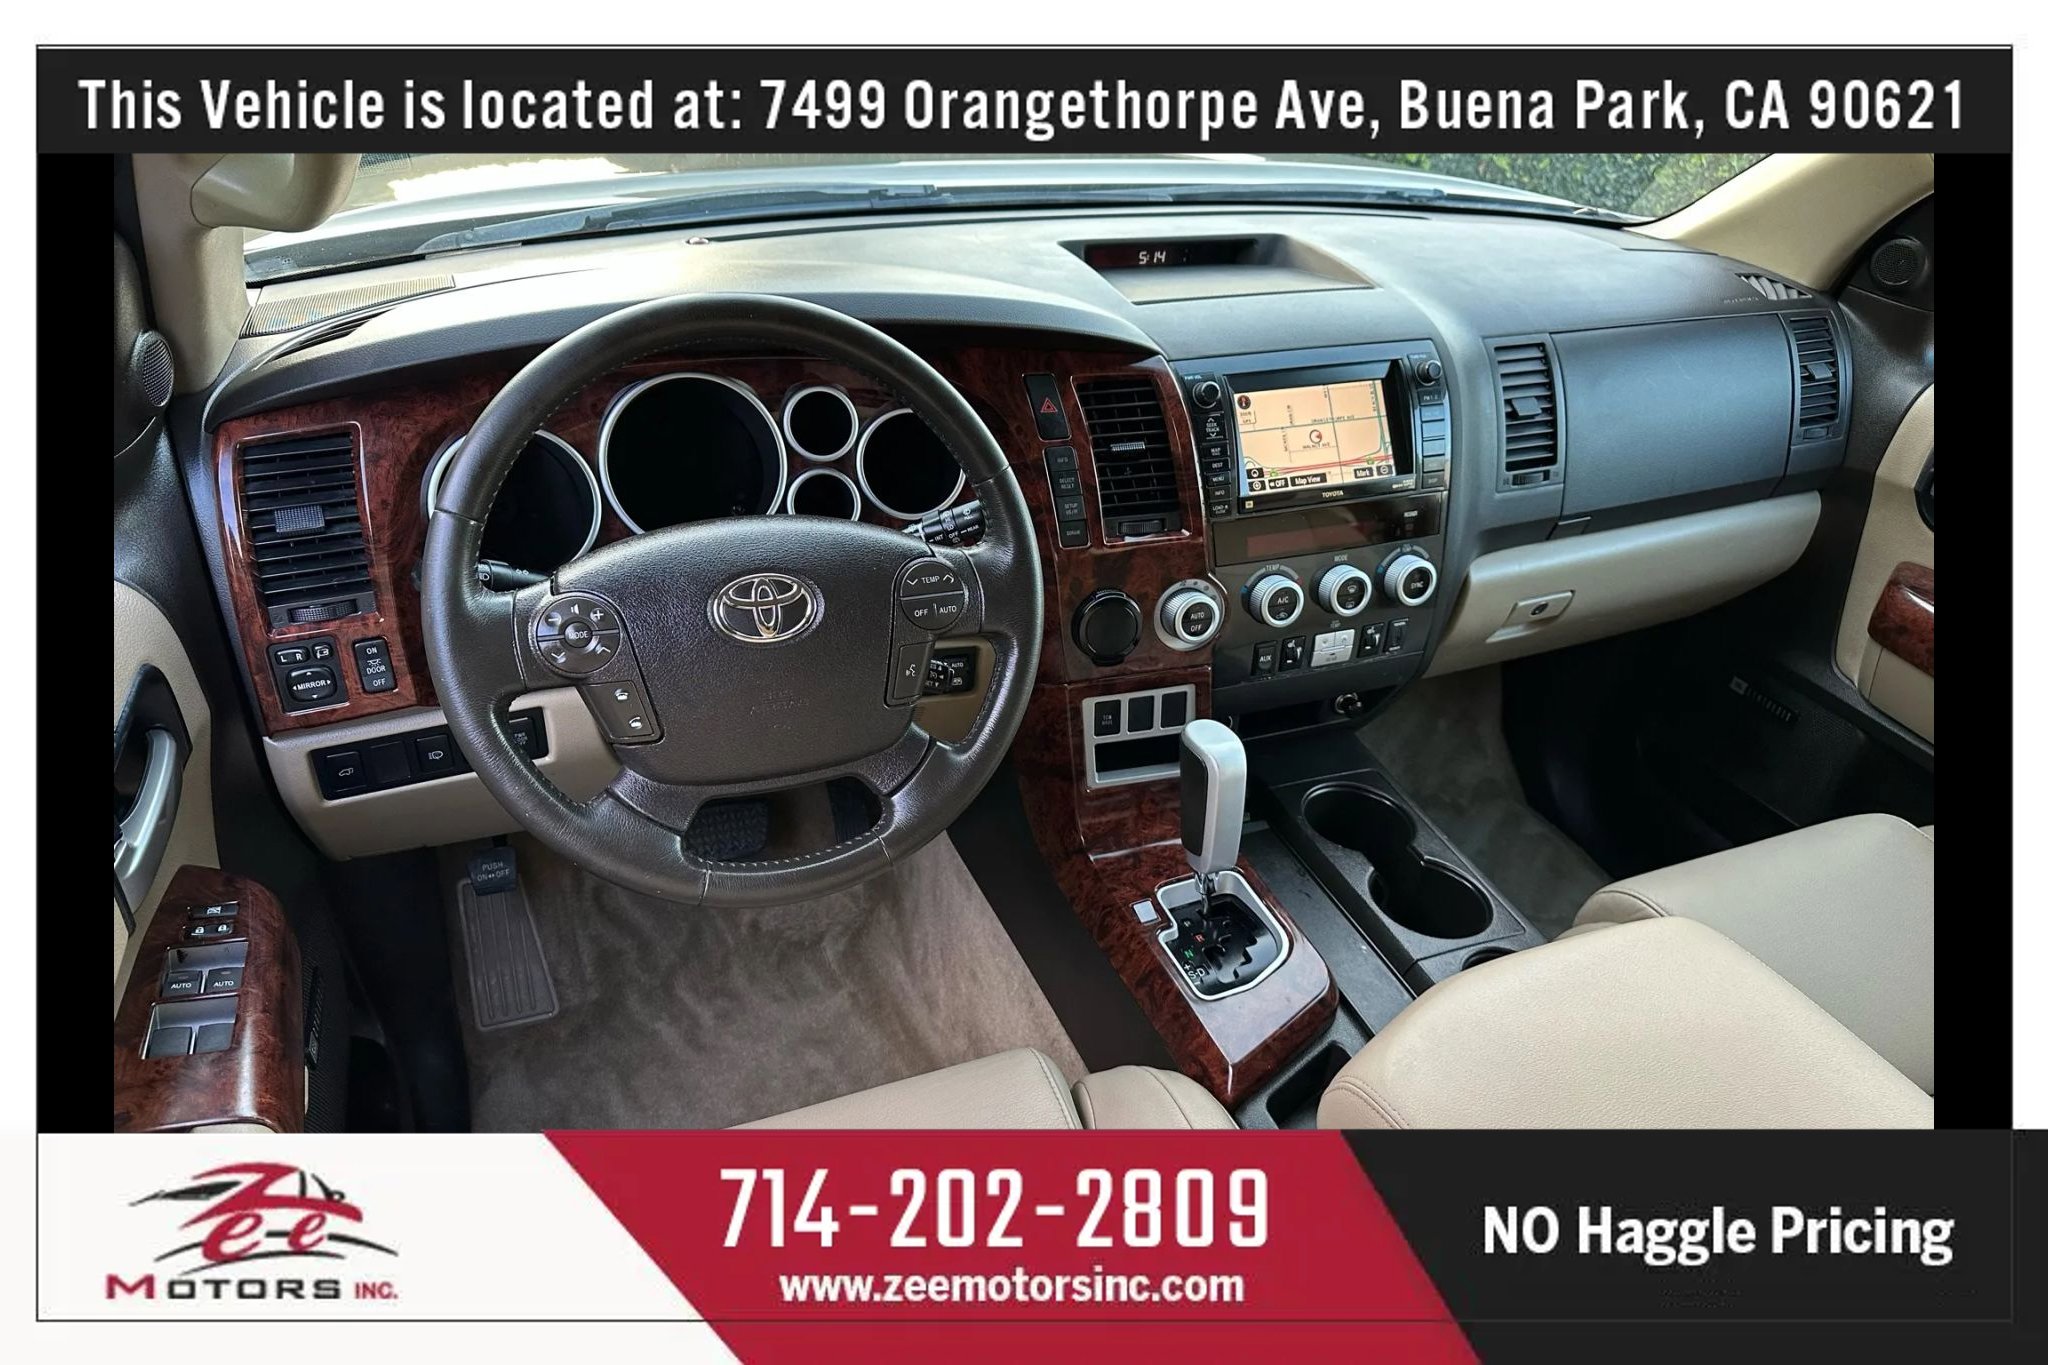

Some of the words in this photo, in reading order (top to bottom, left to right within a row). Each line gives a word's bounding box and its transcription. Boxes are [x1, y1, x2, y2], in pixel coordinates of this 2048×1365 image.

[1356, 468, 1370, 477] Mark
[1276, 479, 1285, 487] OFF
[1295, 477, 1307, 486] Map
[1307, 475, 1321, 484] View
[1322, 490, 1344, 498] TOYOTA
[921, 575, 940, 584] TEMP
[1411, 582, 1424, 590] SYNC
[1277, 596, 1289, 605] A/C
[914, 608, 929, 617] OFF
[939, 605, 957, 614] AUTO
[1190, 612, 1205, 620] AUTO
[1190, 624, 1203, 632] OFF
[568, 631, 589, 640] MODE
[280, 654, 287, 662] L
[296, 652, 303, 660] R
[1260, 655, 1272, 663] AUX
[367, 665, 386, 675] DOOR
[297, 680, 327, 691] MIRROR
[373, 678, 386, 687] OFF
[482, 861, 504, 871] PUSH
[477, 872, 488, 881] ON
[496, 869, 510, 878] OFF
[1194, 934, 1205, 943] R
[1184, 949, 1194, 958] N
[1196, 968, 1205, 976] D
[171, 981, 192, 989] AUTO
[213, 980, 234, 988] AUTO
